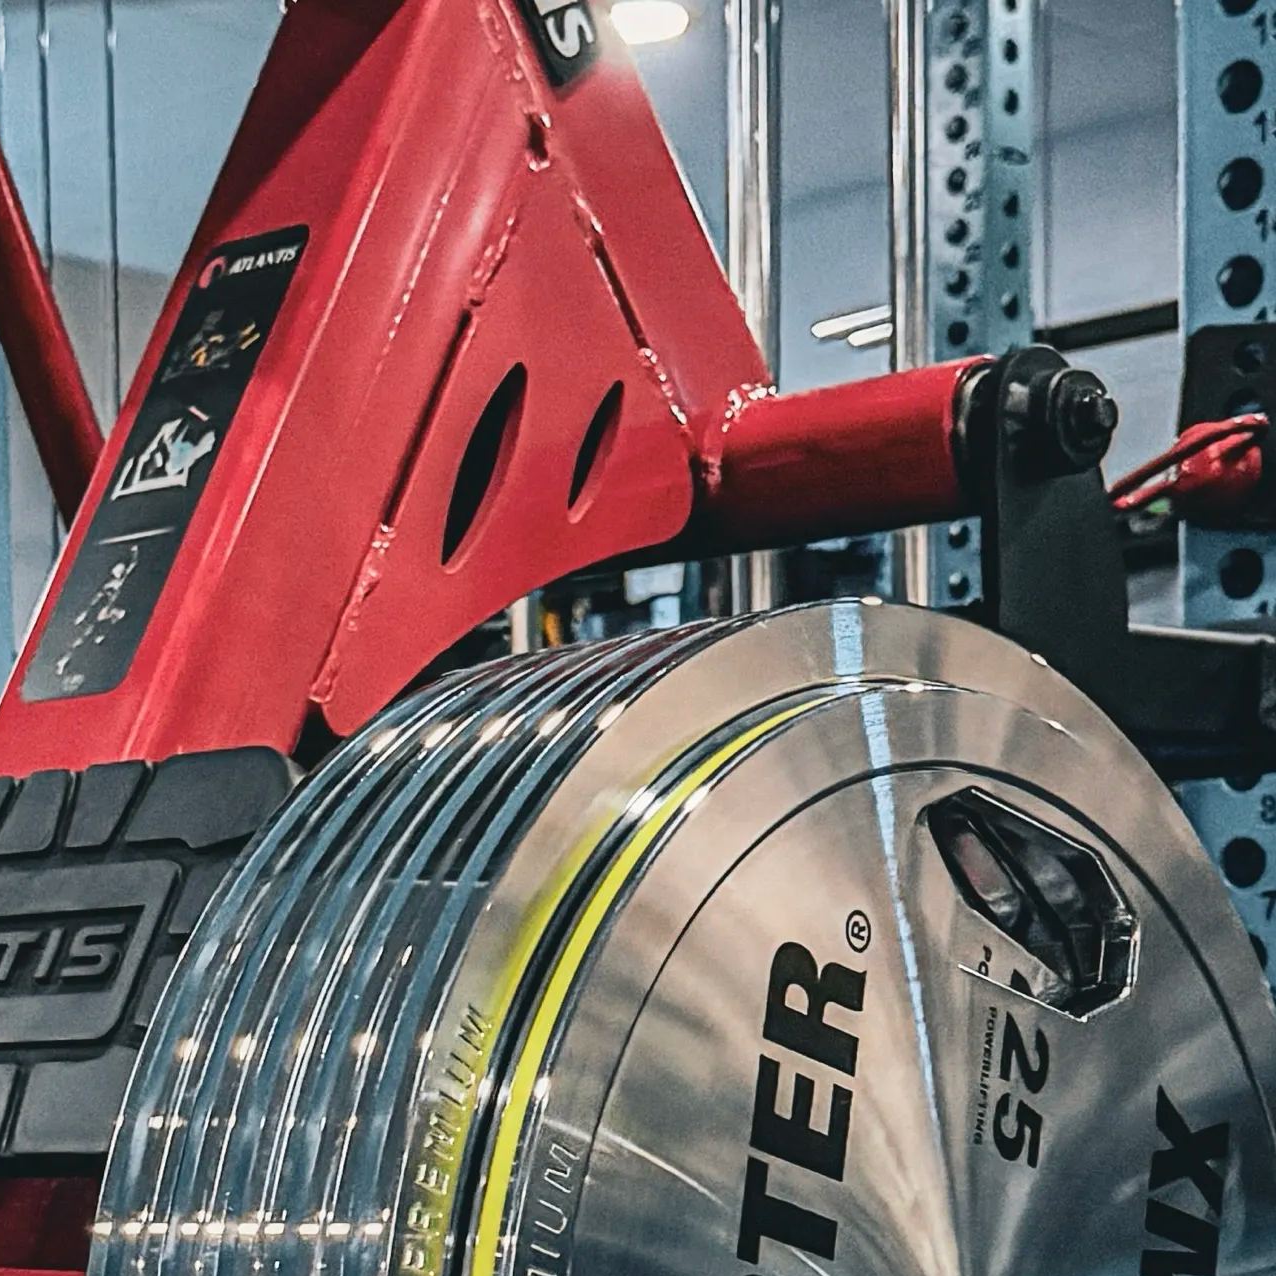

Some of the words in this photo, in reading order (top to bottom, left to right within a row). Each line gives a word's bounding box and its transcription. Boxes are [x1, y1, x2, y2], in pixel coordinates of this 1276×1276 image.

[228, 244, 302, 275] ATLANTIS
[973, 1006, 998, 1145] POWERLIFTING
[993, 1010, 1050, 1169] 25
